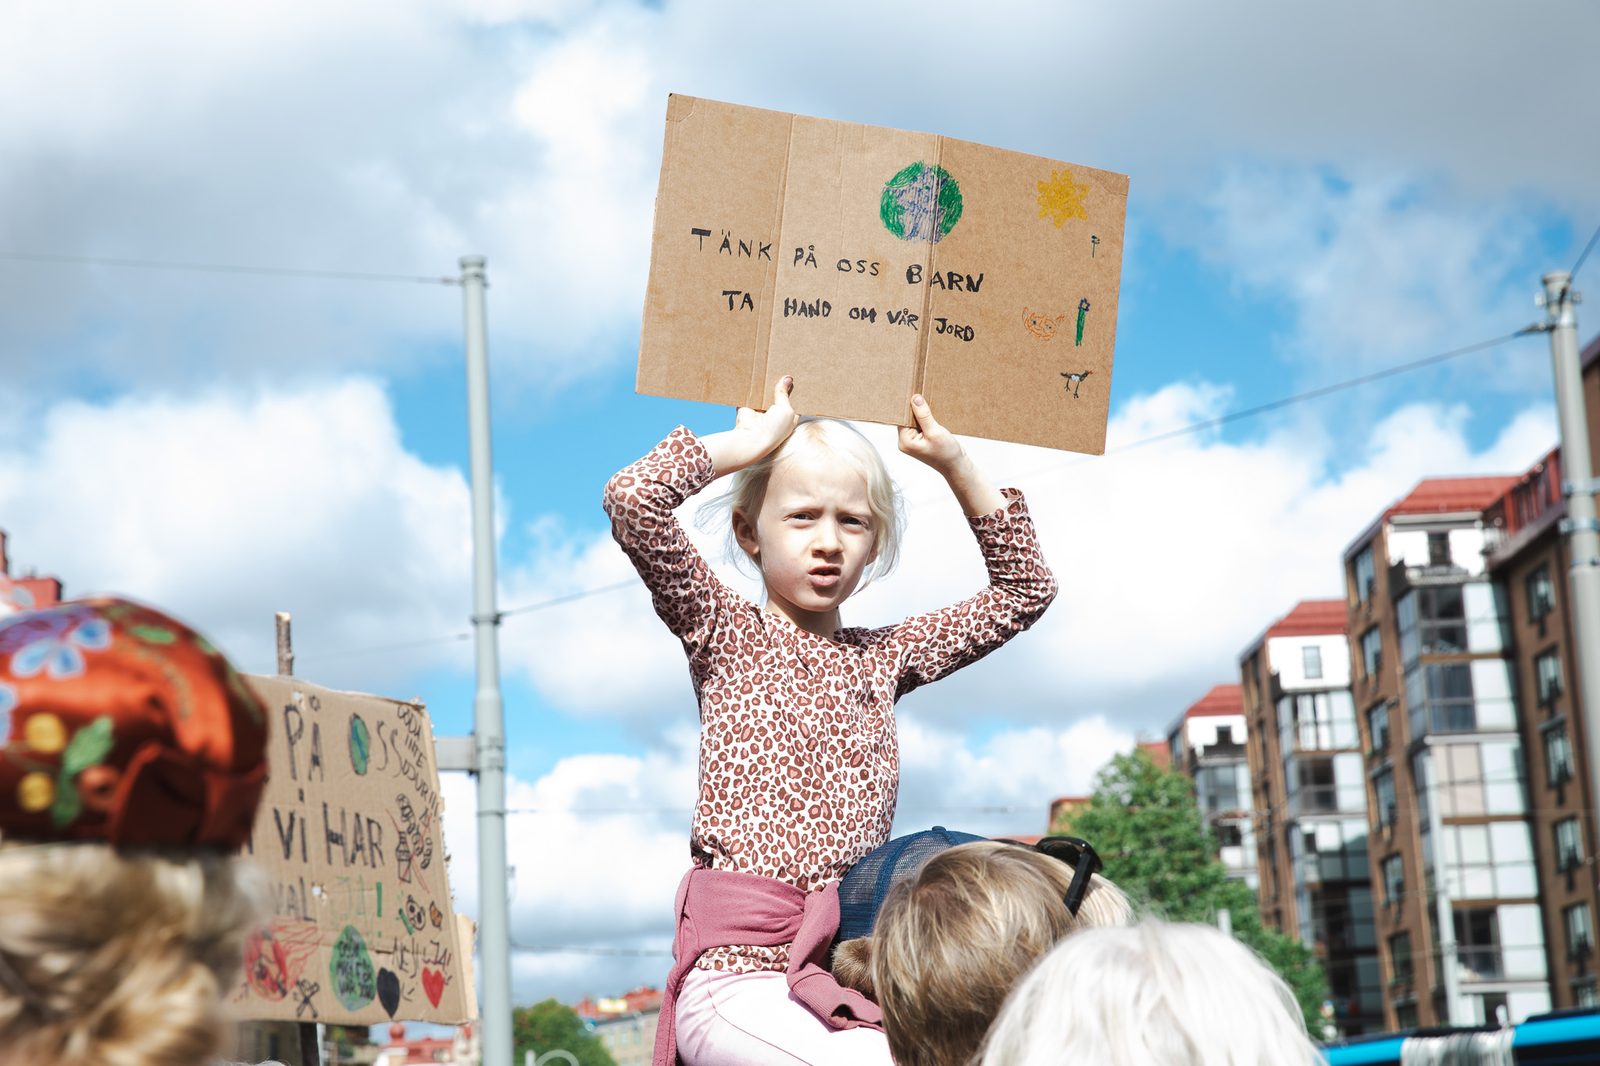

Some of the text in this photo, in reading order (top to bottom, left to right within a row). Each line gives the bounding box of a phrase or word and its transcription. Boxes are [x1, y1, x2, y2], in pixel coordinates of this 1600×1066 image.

[691, 228, 984, 292] TÄNK PÅ OSS BARN
[722, 290, 975, 342] TA HAND OM VÅR JORD
[284, 695, 324, 782] PÅ
[273, 787, 308, 865] VI
[322, 801, 386, 869] HAR
